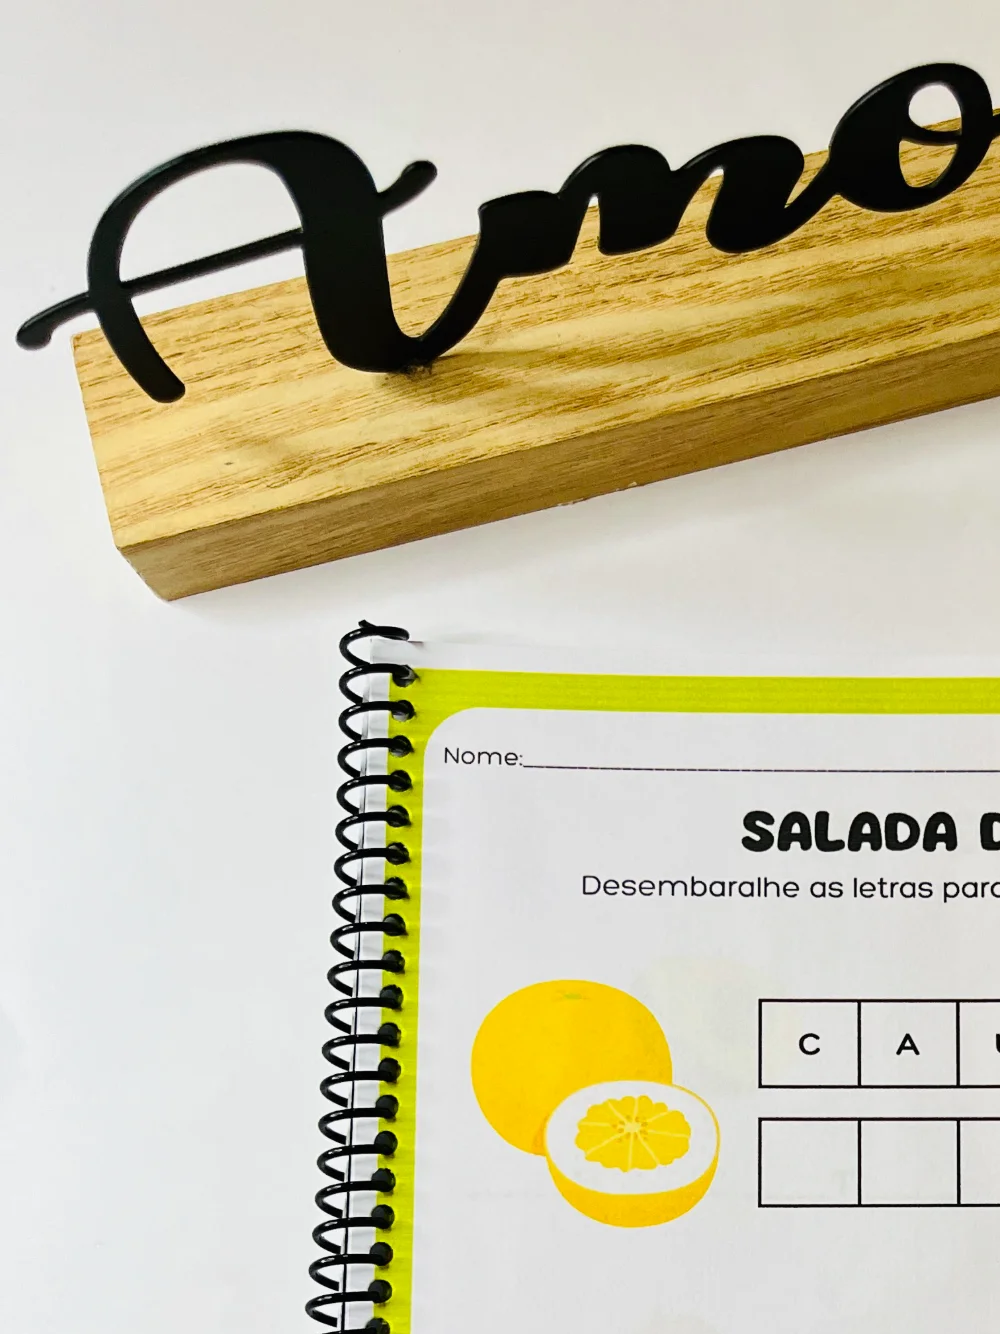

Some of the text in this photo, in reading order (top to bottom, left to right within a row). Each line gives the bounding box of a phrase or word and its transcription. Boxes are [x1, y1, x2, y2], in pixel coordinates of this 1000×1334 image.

[443, 747, 523, 767] Nome:
[741, 810, 958, 853] SALADA
[582, 874, 800, 898] Desembaralhe
[809, 880, 844, 899] as
[853, 877, 934, 899] letras
[798, 1032, 821, 1056] C
[895, 1032, 921, 1056] A
